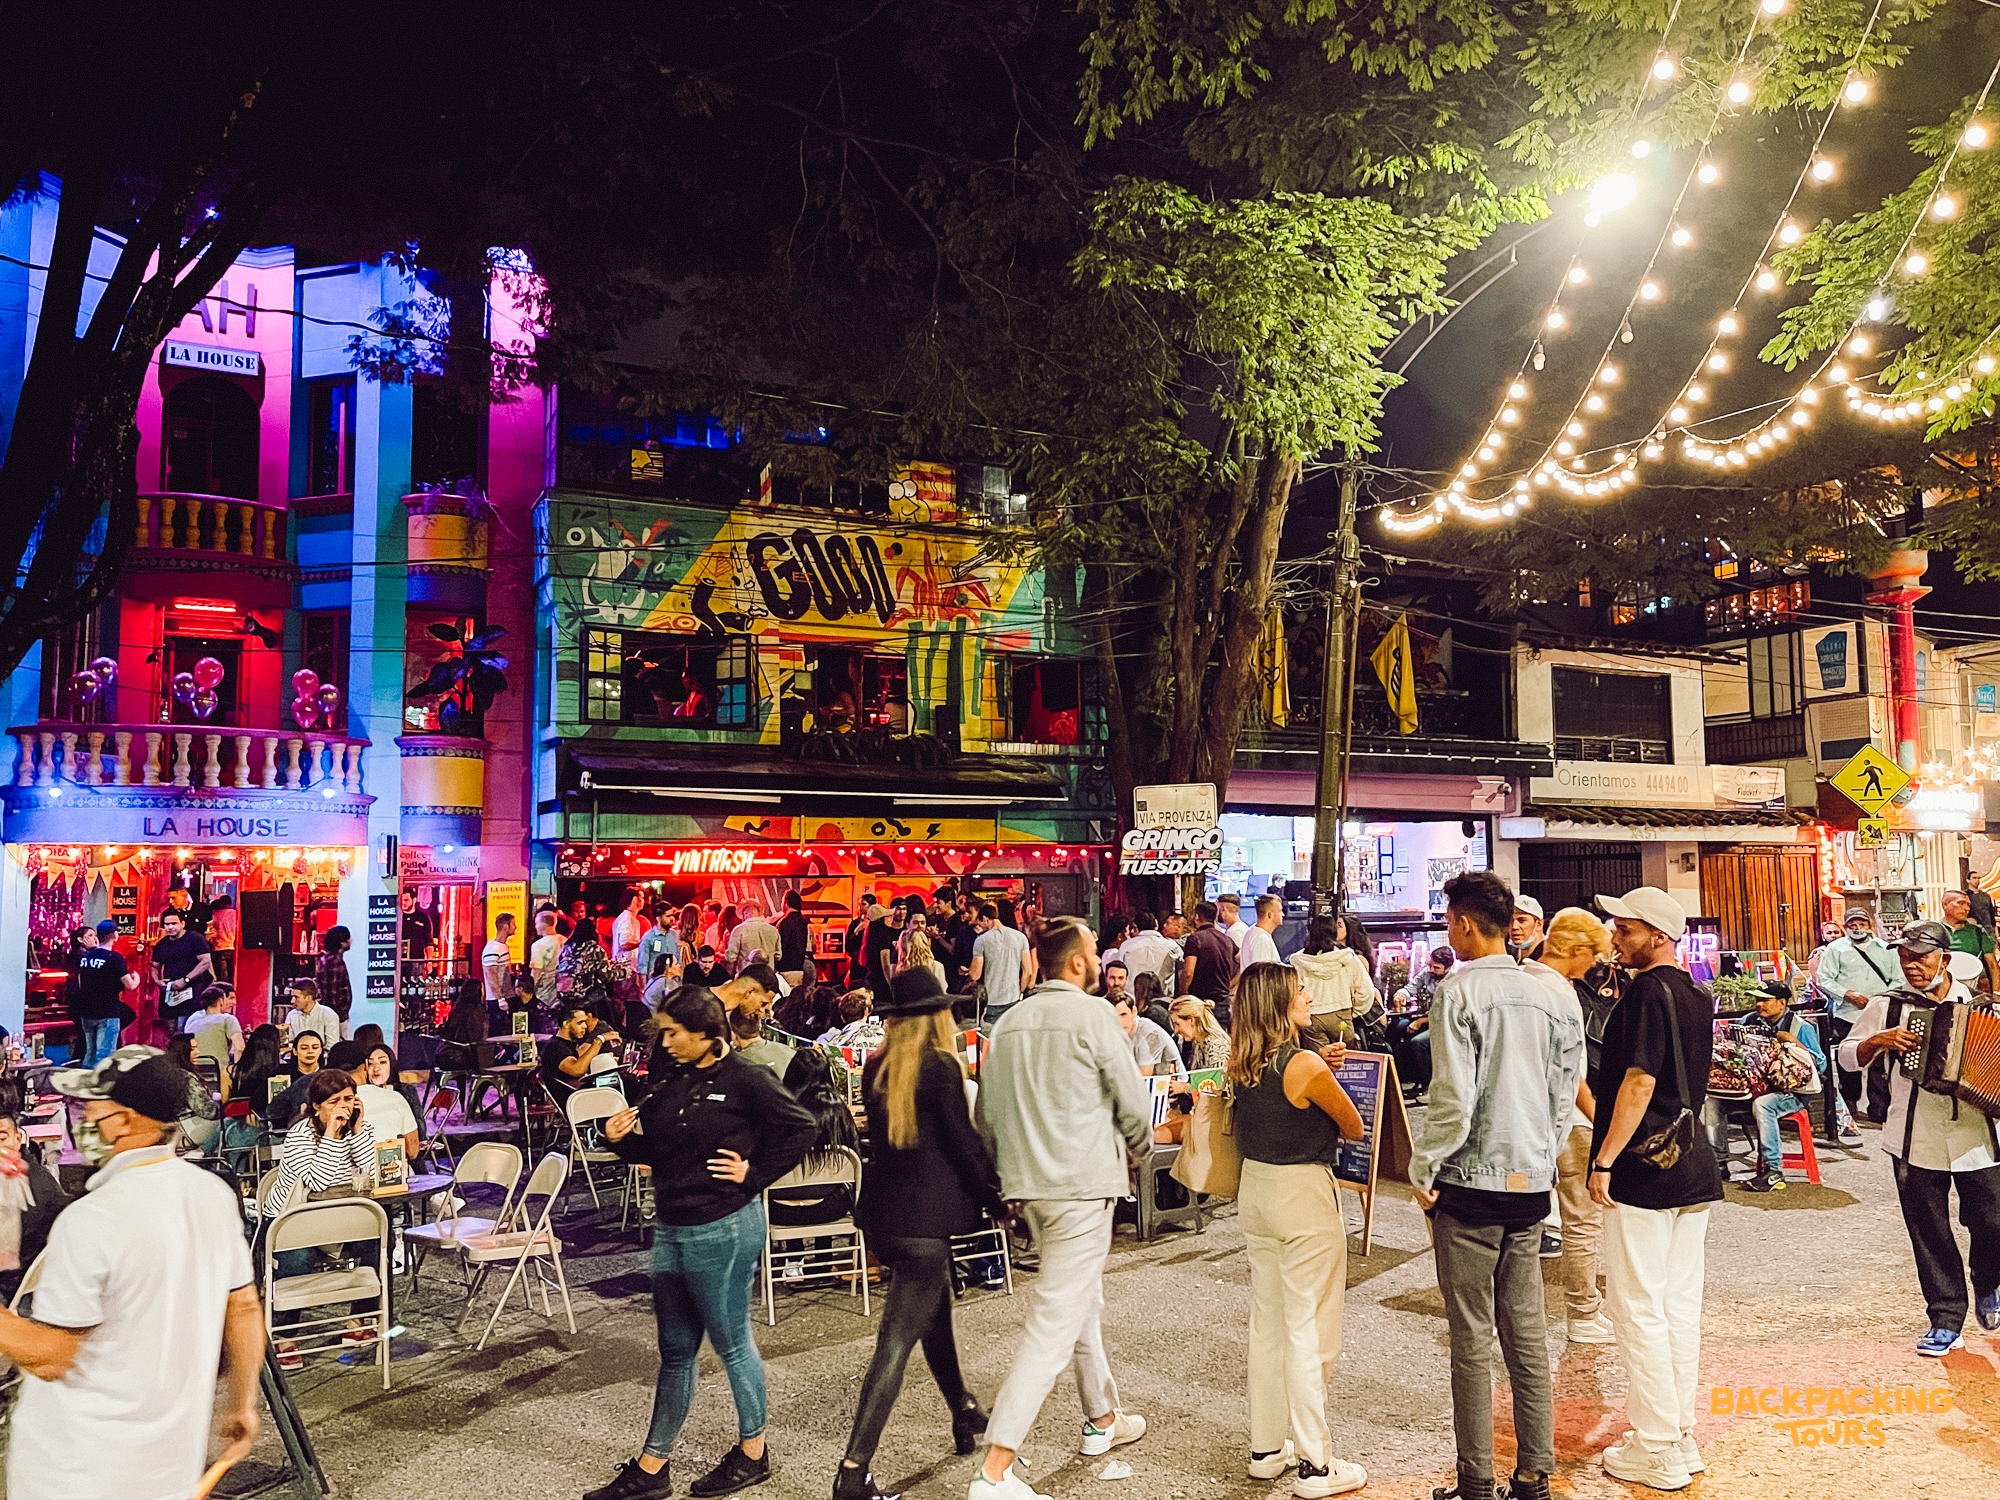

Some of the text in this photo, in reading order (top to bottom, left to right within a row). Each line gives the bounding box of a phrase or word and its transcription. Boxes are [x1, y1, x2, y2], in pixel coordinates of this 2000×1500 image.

[170, 346, 255, 370] LA HOUSE
[1558, 768, 1637, 788] Orientamos
[1139, 810, 1213, 824] VIA PROVENZA
[143, 817, 289, 837] LA HOUSE
[1122, 828, 1224, 850] GRINGO
[672, 848, 755, 874] VINTRASH
[1120, 859, 1220, 875] TUESDAYS
[120, 888, 131, 897] LA
[113, 897, 137, 906] HOUSE
[377, 898, 389, 906] LA
[369, 907, 397, 916] HOUSE
[118, 916, 129, 925] LA
[117, 926, 136, 935] OUSE
[376, 924, 388, 932] LA
[369, 933, 396, 941] HOUSE
[376, 951, 388, 959] LA
[368, 960, 395, 968] HOUSE
[374, 979, 386, 987] LA
[367, 987, 394, 996] HOUSE
